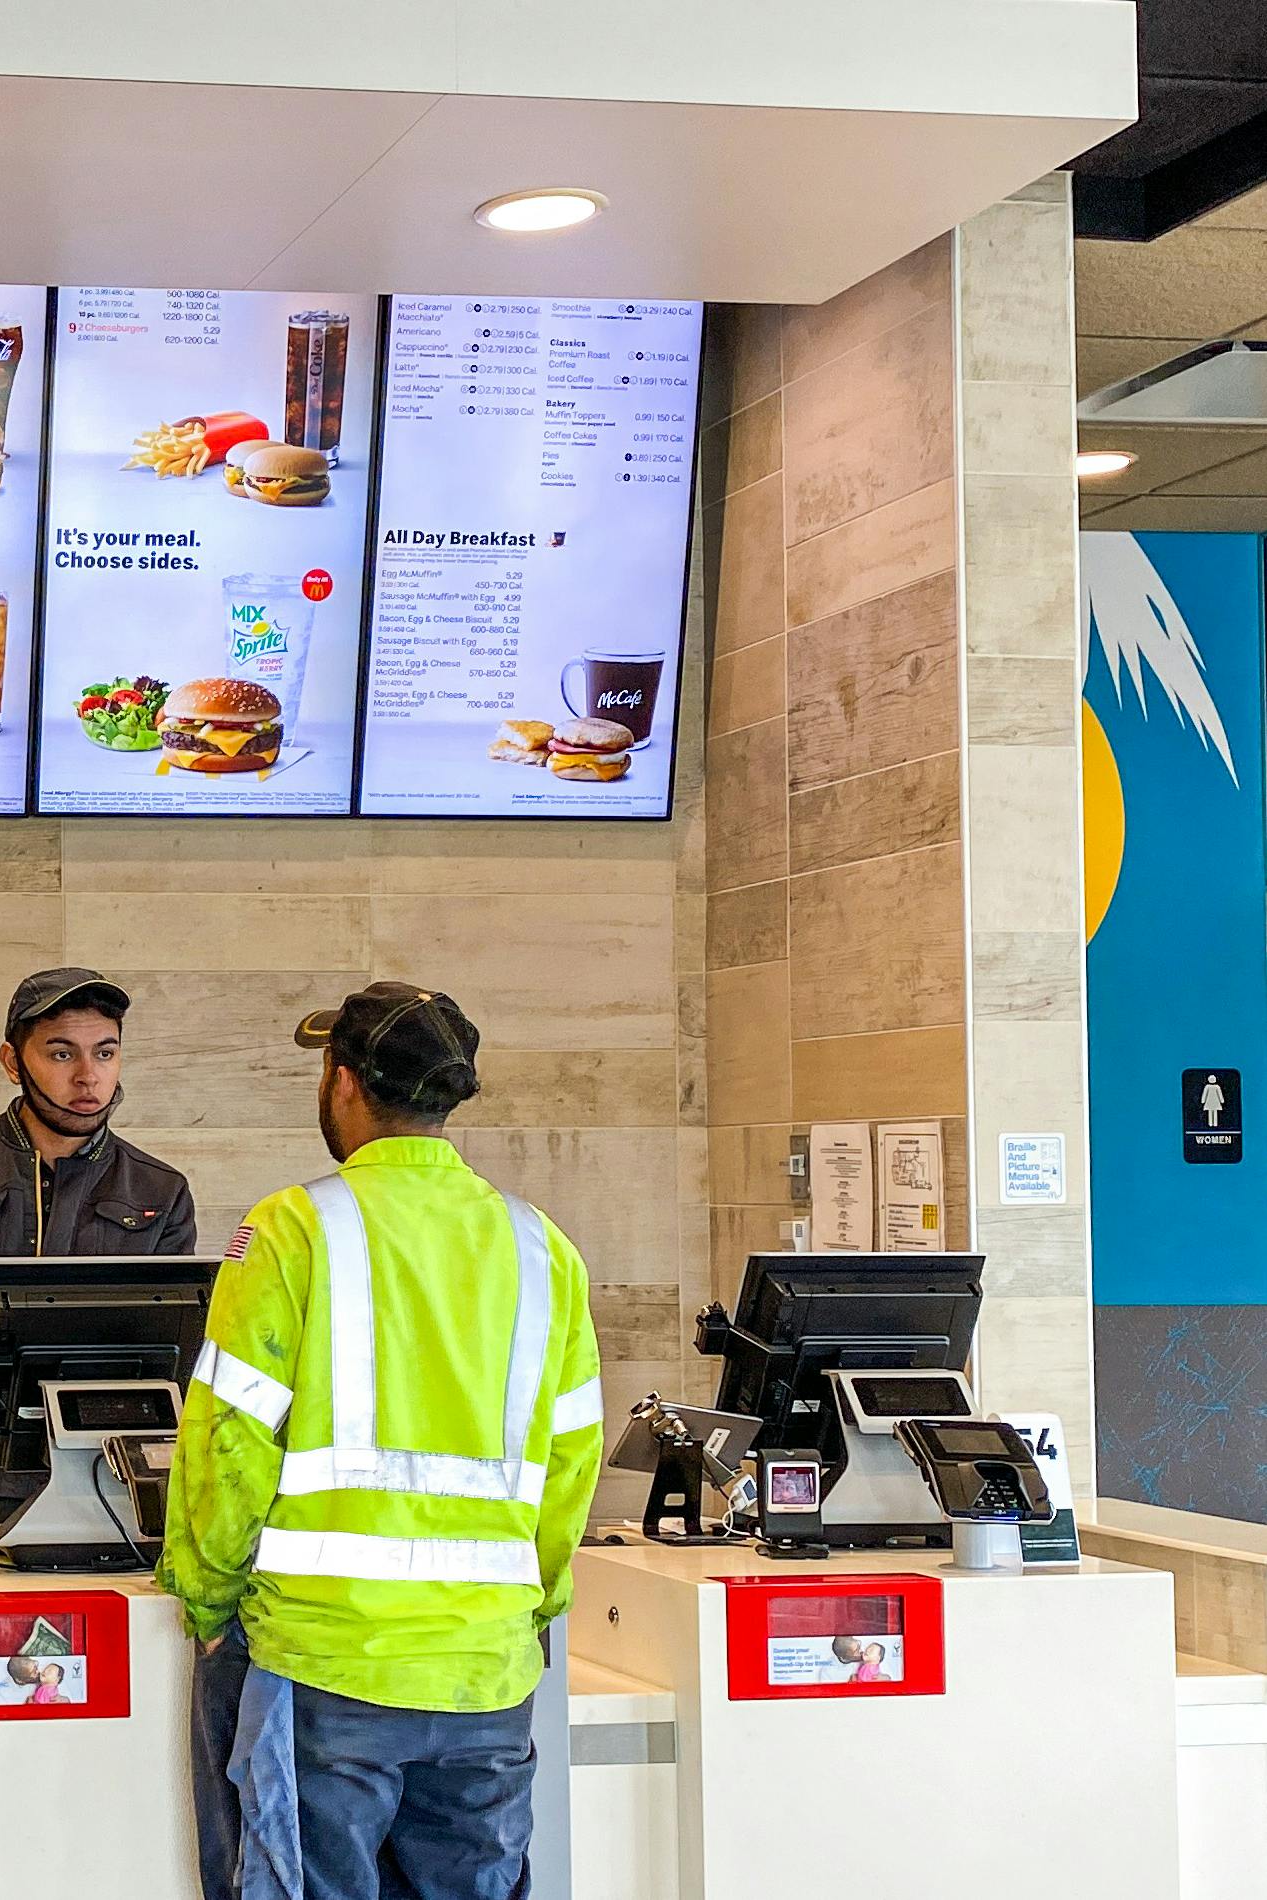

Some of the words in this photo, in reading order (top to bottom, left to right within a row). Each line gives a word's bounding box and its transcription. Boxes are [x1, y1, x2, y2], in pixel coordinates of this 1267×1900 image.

[552, 303, 591, 312] Smoothie
[69, 323, 76, 333] 9
[85, 324, 148, 333] Cheeseburgers
[397, 328, 441, 336] Americano
[550, 339, 586, 347] Classics
[588, 351, 610, 359] Roast
[546, 400, 575, 408] Bakery
[546, 411, 571, 419] Muffin
[573, 412, 606, 420] Toppers
[544, 432, 571, 440] Coffee
[573, 432, 597, 440] Cakes
[541, 472, 573, 480] Cookies
[93, 532, 140, 550] your
[145, 530, 201, 547] meal.
[384, 530, 407, 544] All
[413, 531, 445, 548] Day
[450, 532, 536, 546] Breakfast
[56, 551, 133, 568] Choose
[138, 551, 198, 570] sides.
[232, 604, 266, 622] MIX
[408, 616, 423, 624] Egg
[235, 630, 283, 660] Sprite
[462, 638, 477, 647] Egg
[412, 691, 427, 700] Egg
[1196, 1136, 1231, 1144] WOMEN
[1008, 1143, 1036, 1151] Braille
[1008, 1162, 1040, 1170] Picture
[1009, 1182, 1050, 1190] Available
